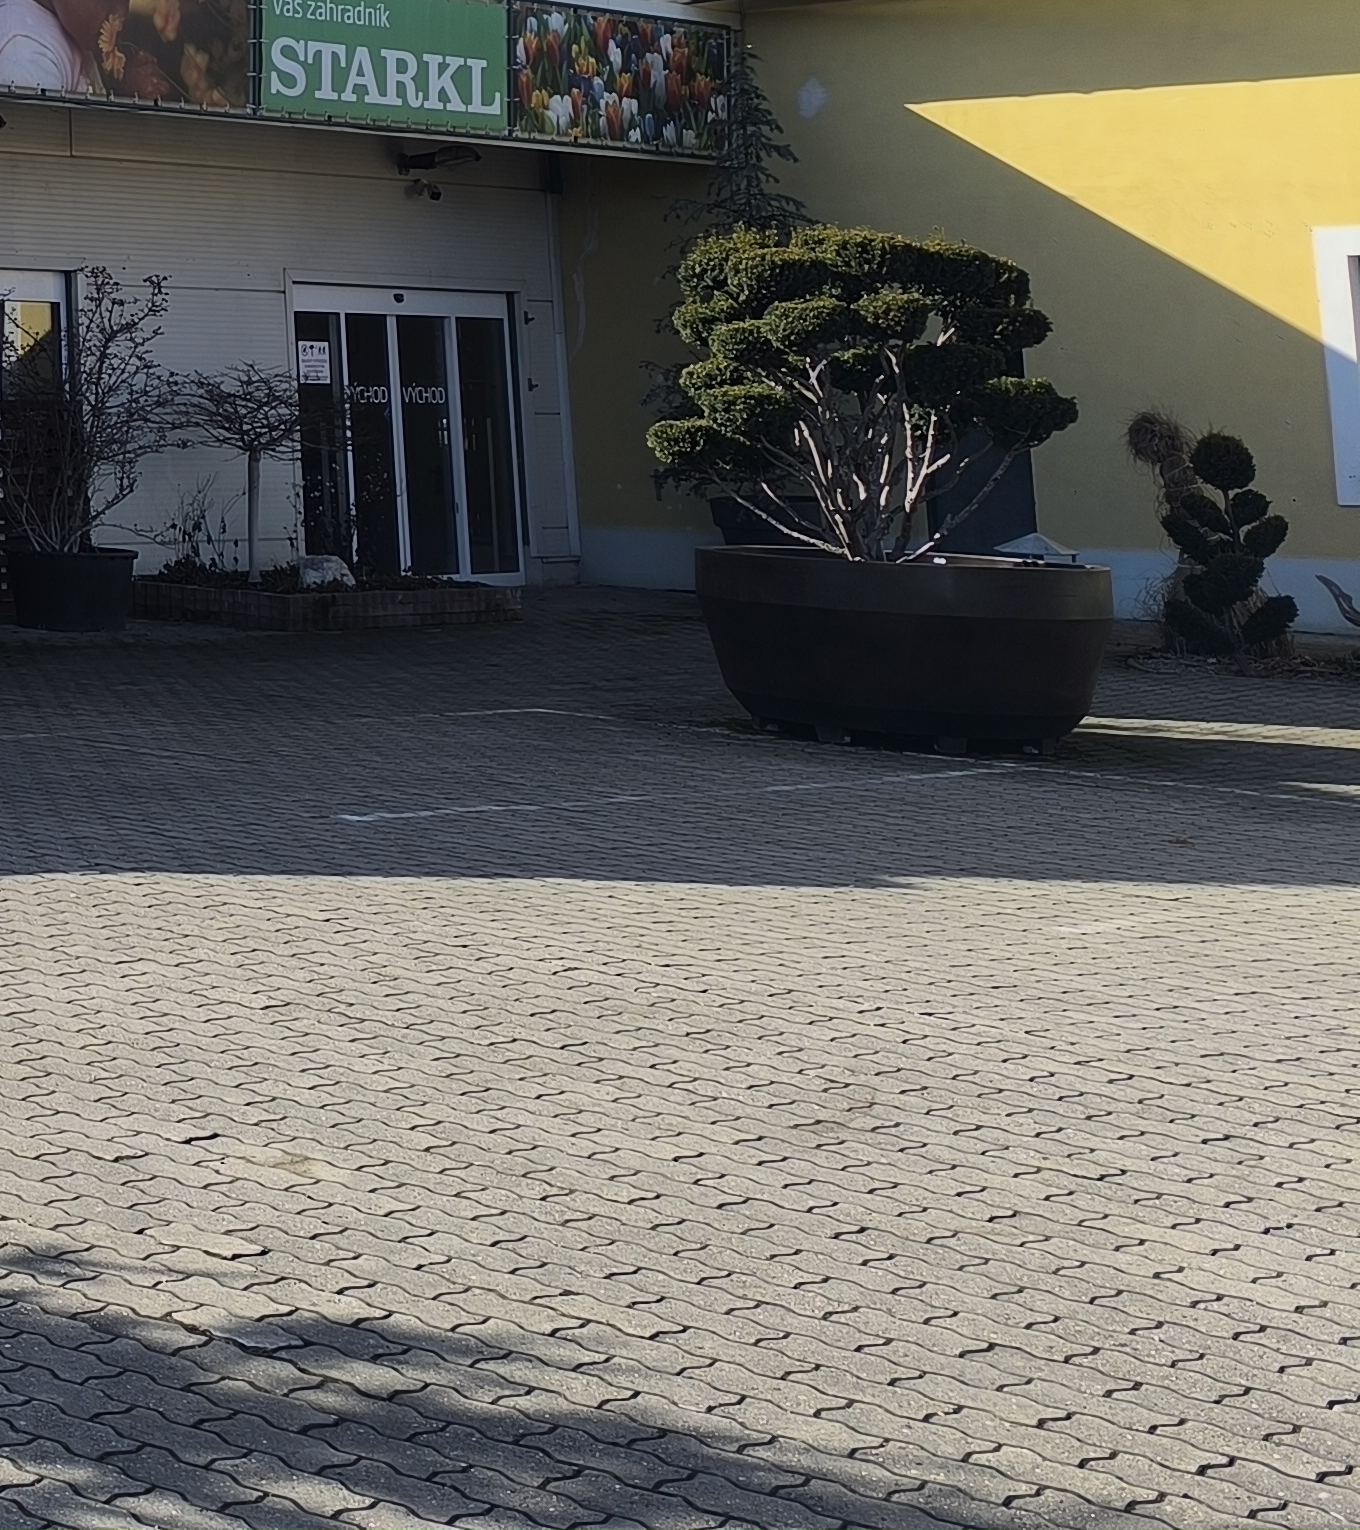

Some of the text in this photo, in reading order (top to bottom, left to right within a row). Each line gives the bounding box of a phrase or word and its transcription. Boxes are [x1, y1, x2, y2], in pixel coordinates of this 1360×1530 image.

[270, 37, 501, 115] STARKL
[350, 382, 446, 403] ÝCHOD VÝCHOD
